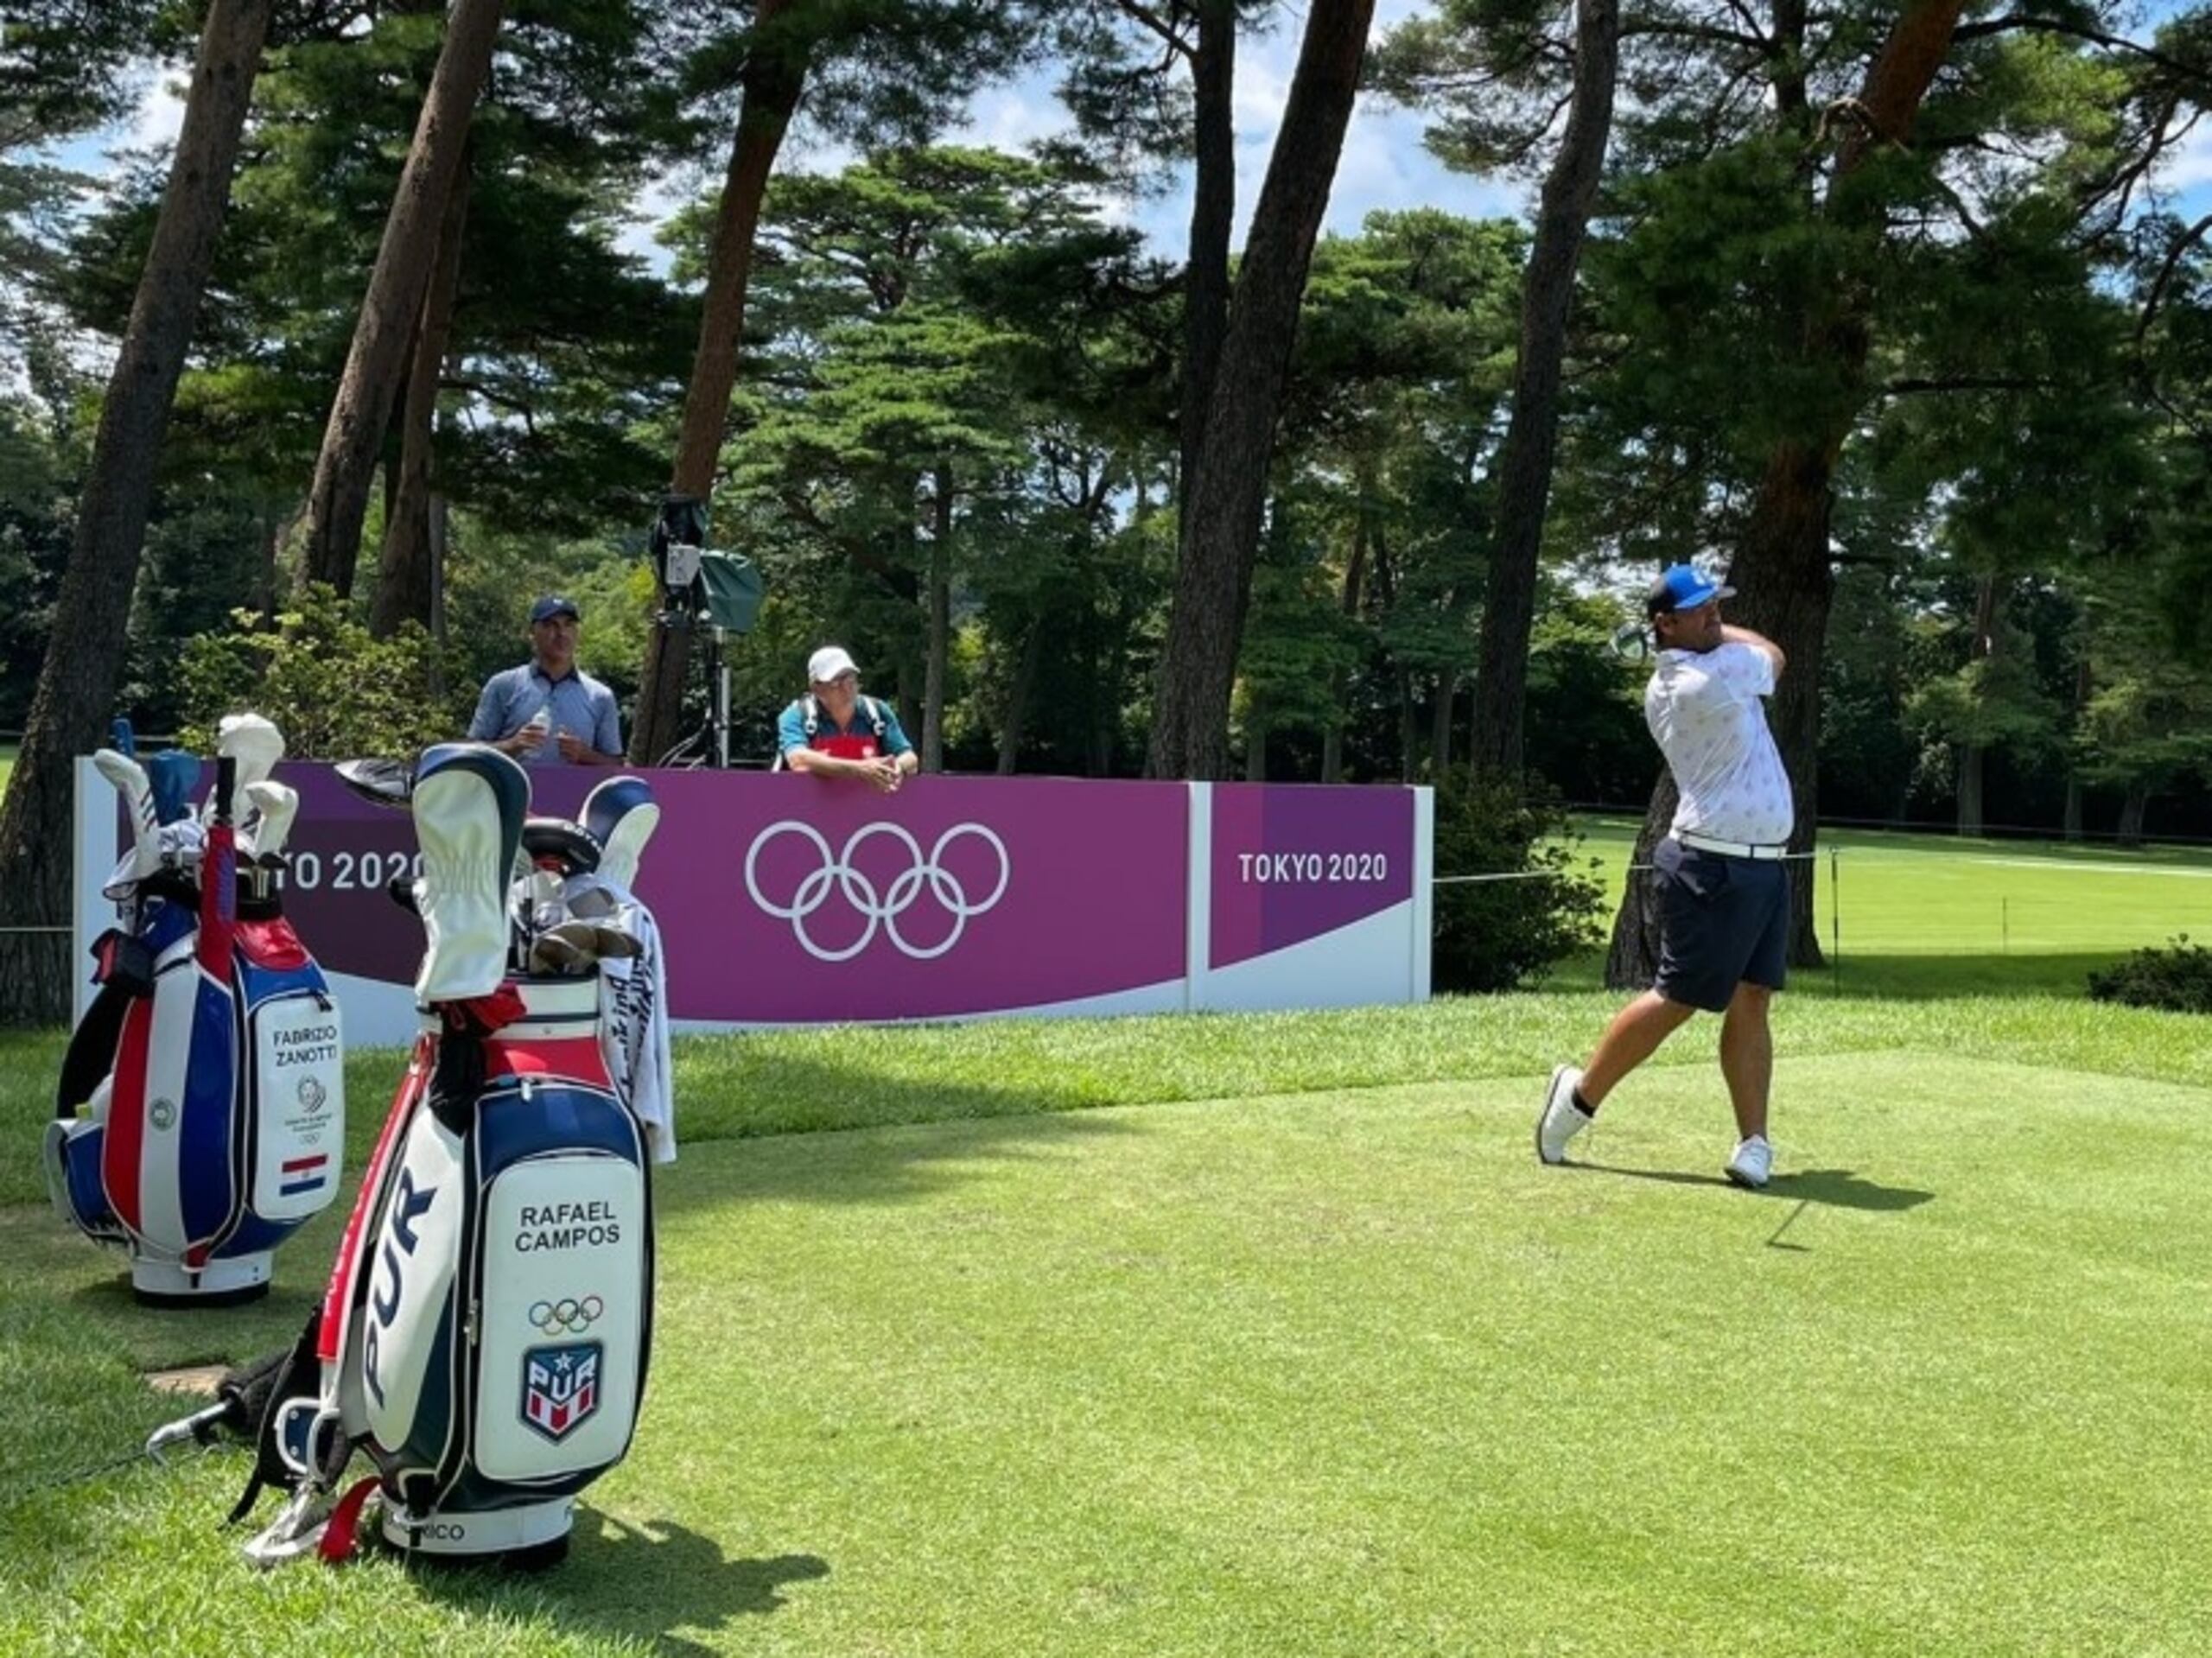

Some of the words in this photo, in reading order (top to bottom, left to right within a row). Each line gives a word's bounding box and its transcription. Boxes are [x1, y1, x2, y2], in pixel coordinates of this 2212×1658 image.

[1238, 854, 1323, 882] TOKYO
[1328, 854, 1388, 881] 2020
[273, 1025, 337, 1046] FABRIZIO
[276, 1045, 336, 1067] ZANOTTI
[520, 1201, 617, 1227] RAFAEL
[515, 1223, 620, 1252] CAMPOS
[365, 1166, 438, 1409] PUR
[529, 1354, 596, 1401] PUR
